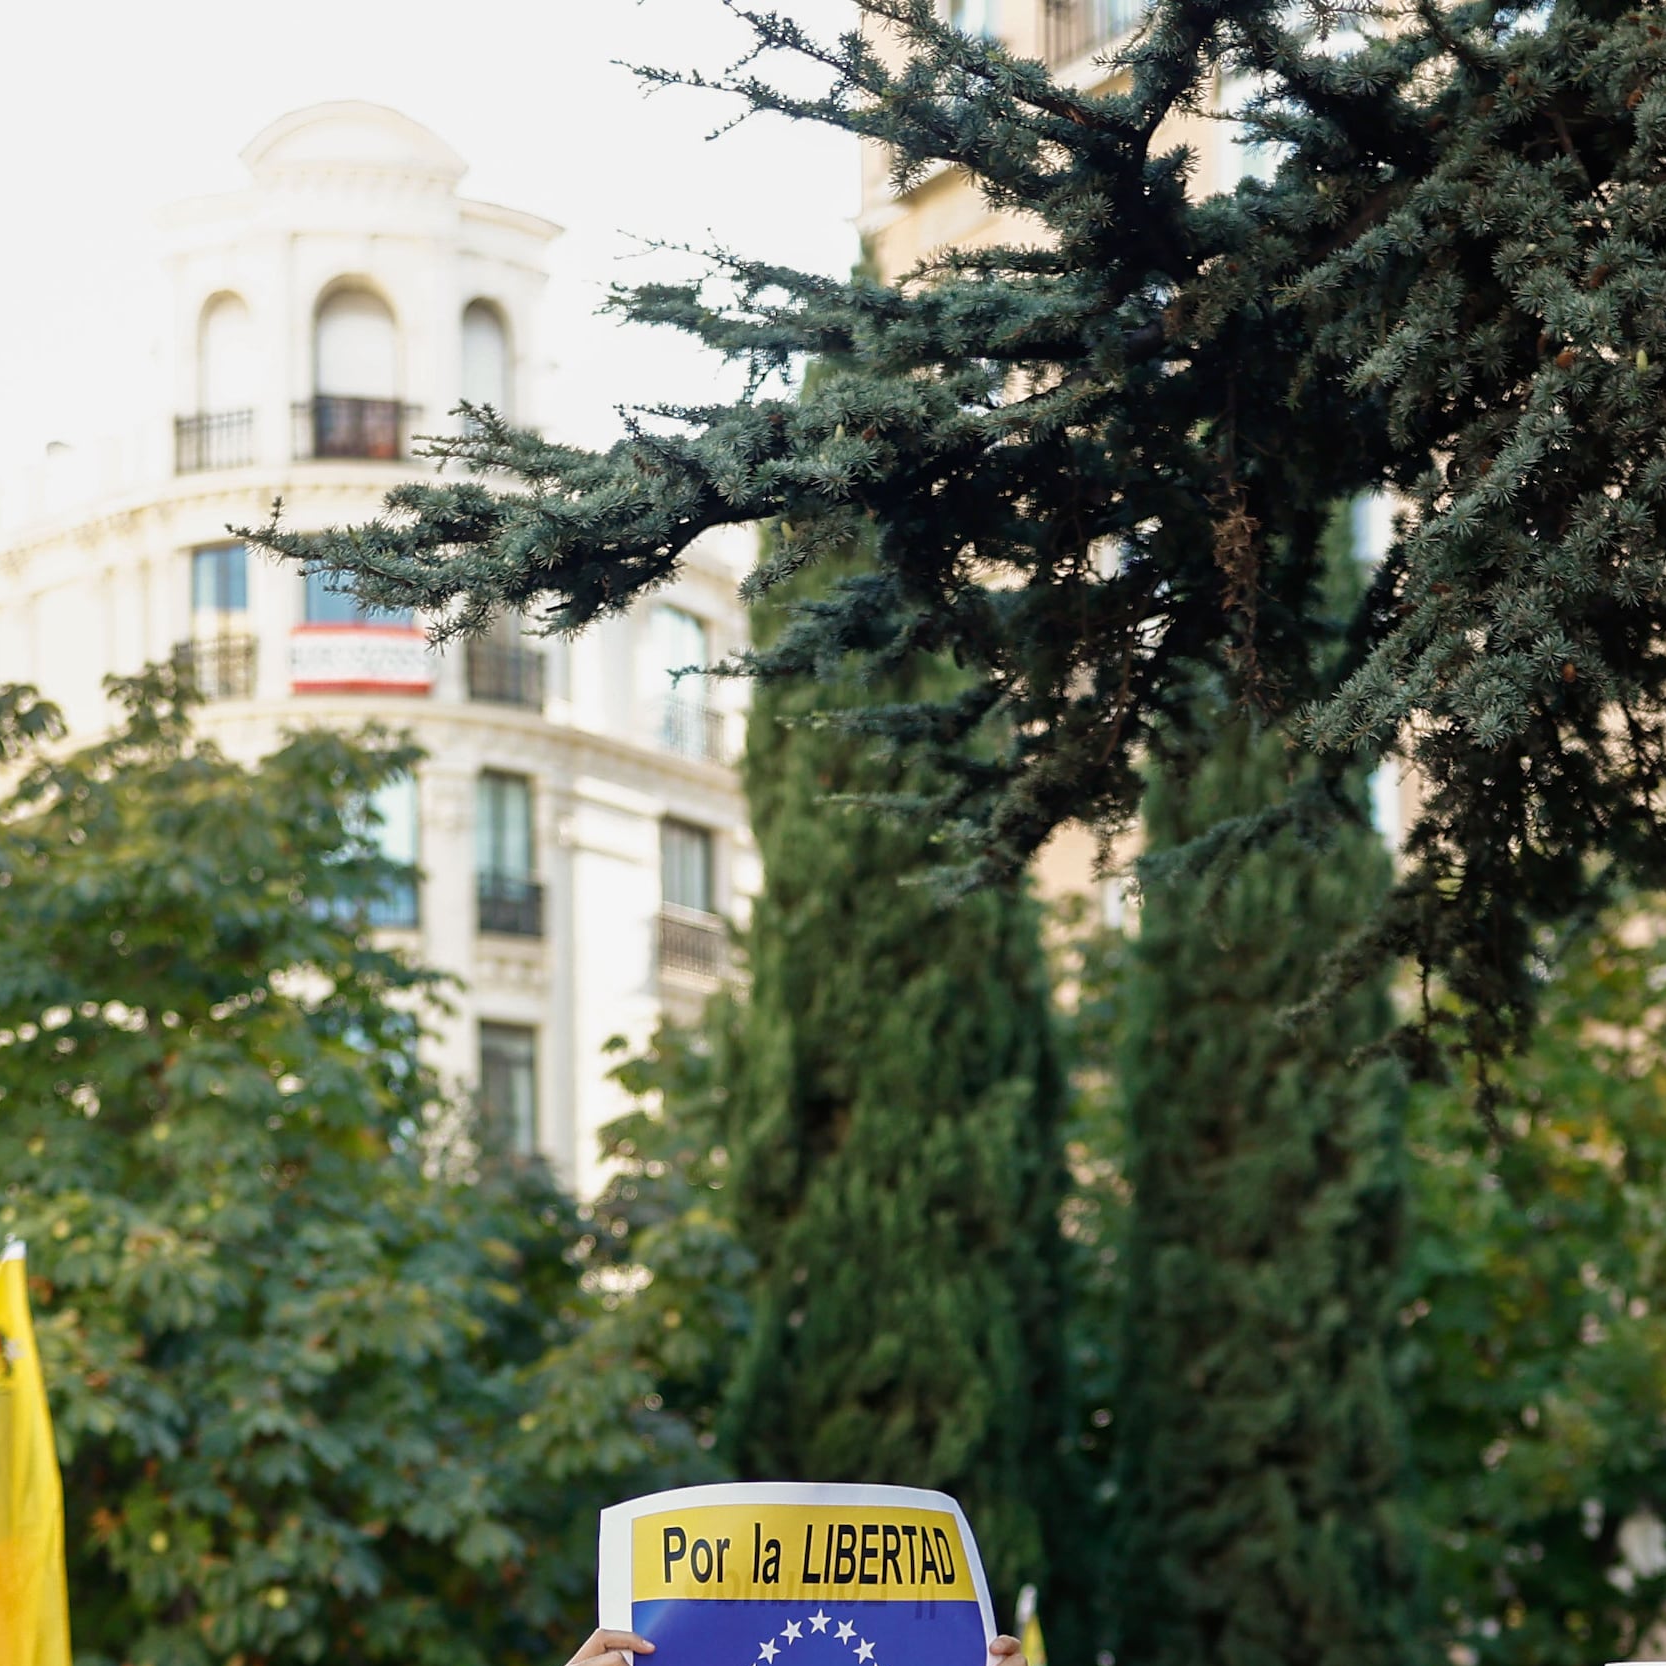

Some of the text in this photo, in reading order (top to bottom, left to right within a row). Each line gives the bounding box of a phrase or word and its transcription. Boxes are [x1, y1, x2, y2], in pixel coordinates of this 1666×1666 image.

[662, 1522, 956, 1585] Por la LIBERTAD
